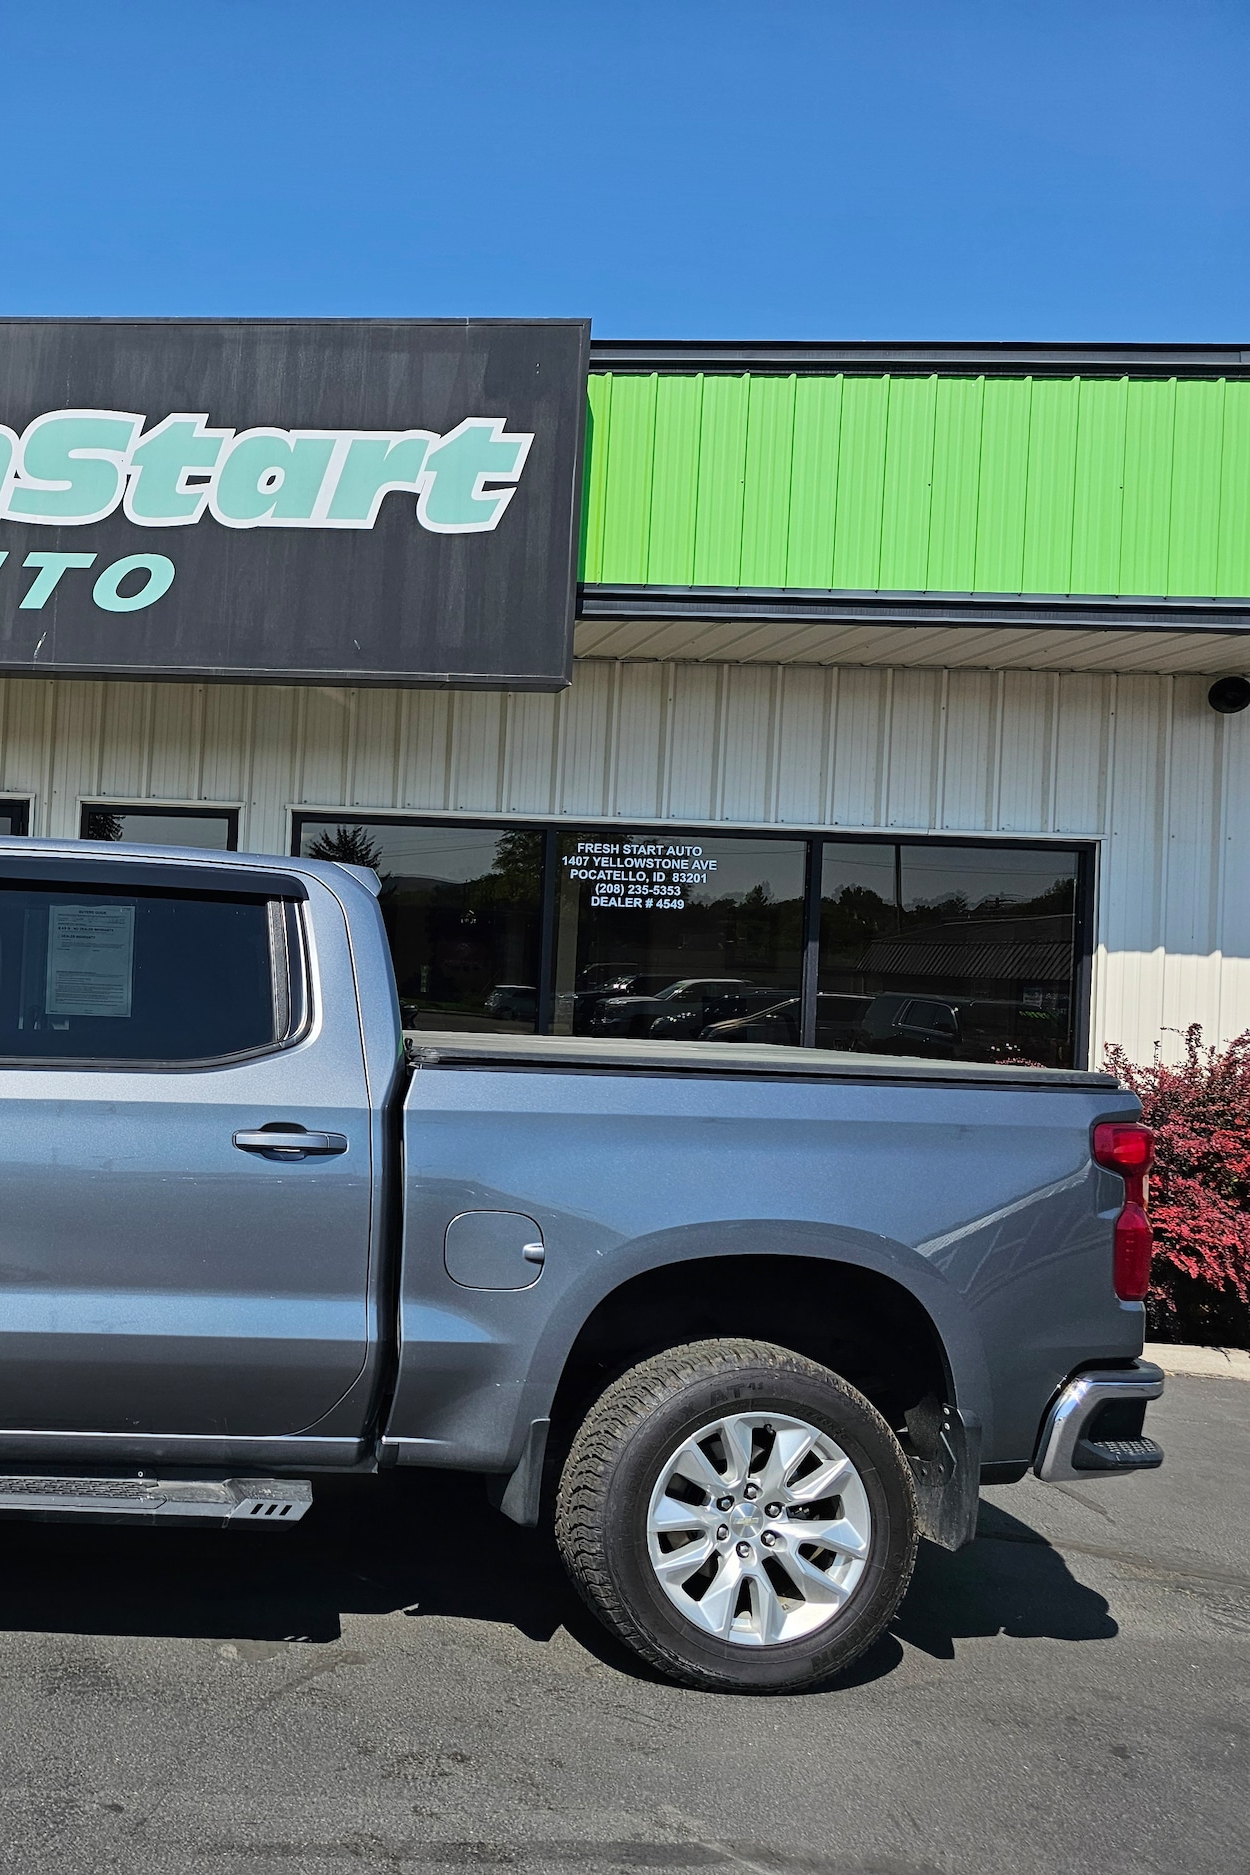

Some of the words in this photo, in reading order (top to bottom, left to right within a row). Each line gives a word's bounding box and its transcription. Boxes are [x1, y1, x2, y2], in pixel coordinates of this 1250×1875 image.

[577, 843, 619, 855] FRESH
[623, 844, 664, 856] START
[666, 845, 702, 857] AUTO
[562, 856, 588, 867] 1407
[592, 857, 689, 870] YELLOWSTONE
[691, 860, 717, 870] AVE
[570, 869, 649, 883] POCATELLO,
[653, 871, 666, 882] ID
[672, 872, 707, 883] 83201
[595, 883, 625, 896] (208)
[627, 884, 681, 896] 235-5353
[591, 896, 642, 908] DEALER
[645, 898, 653, 908] #
[656, 898, 684, 909] 4549
